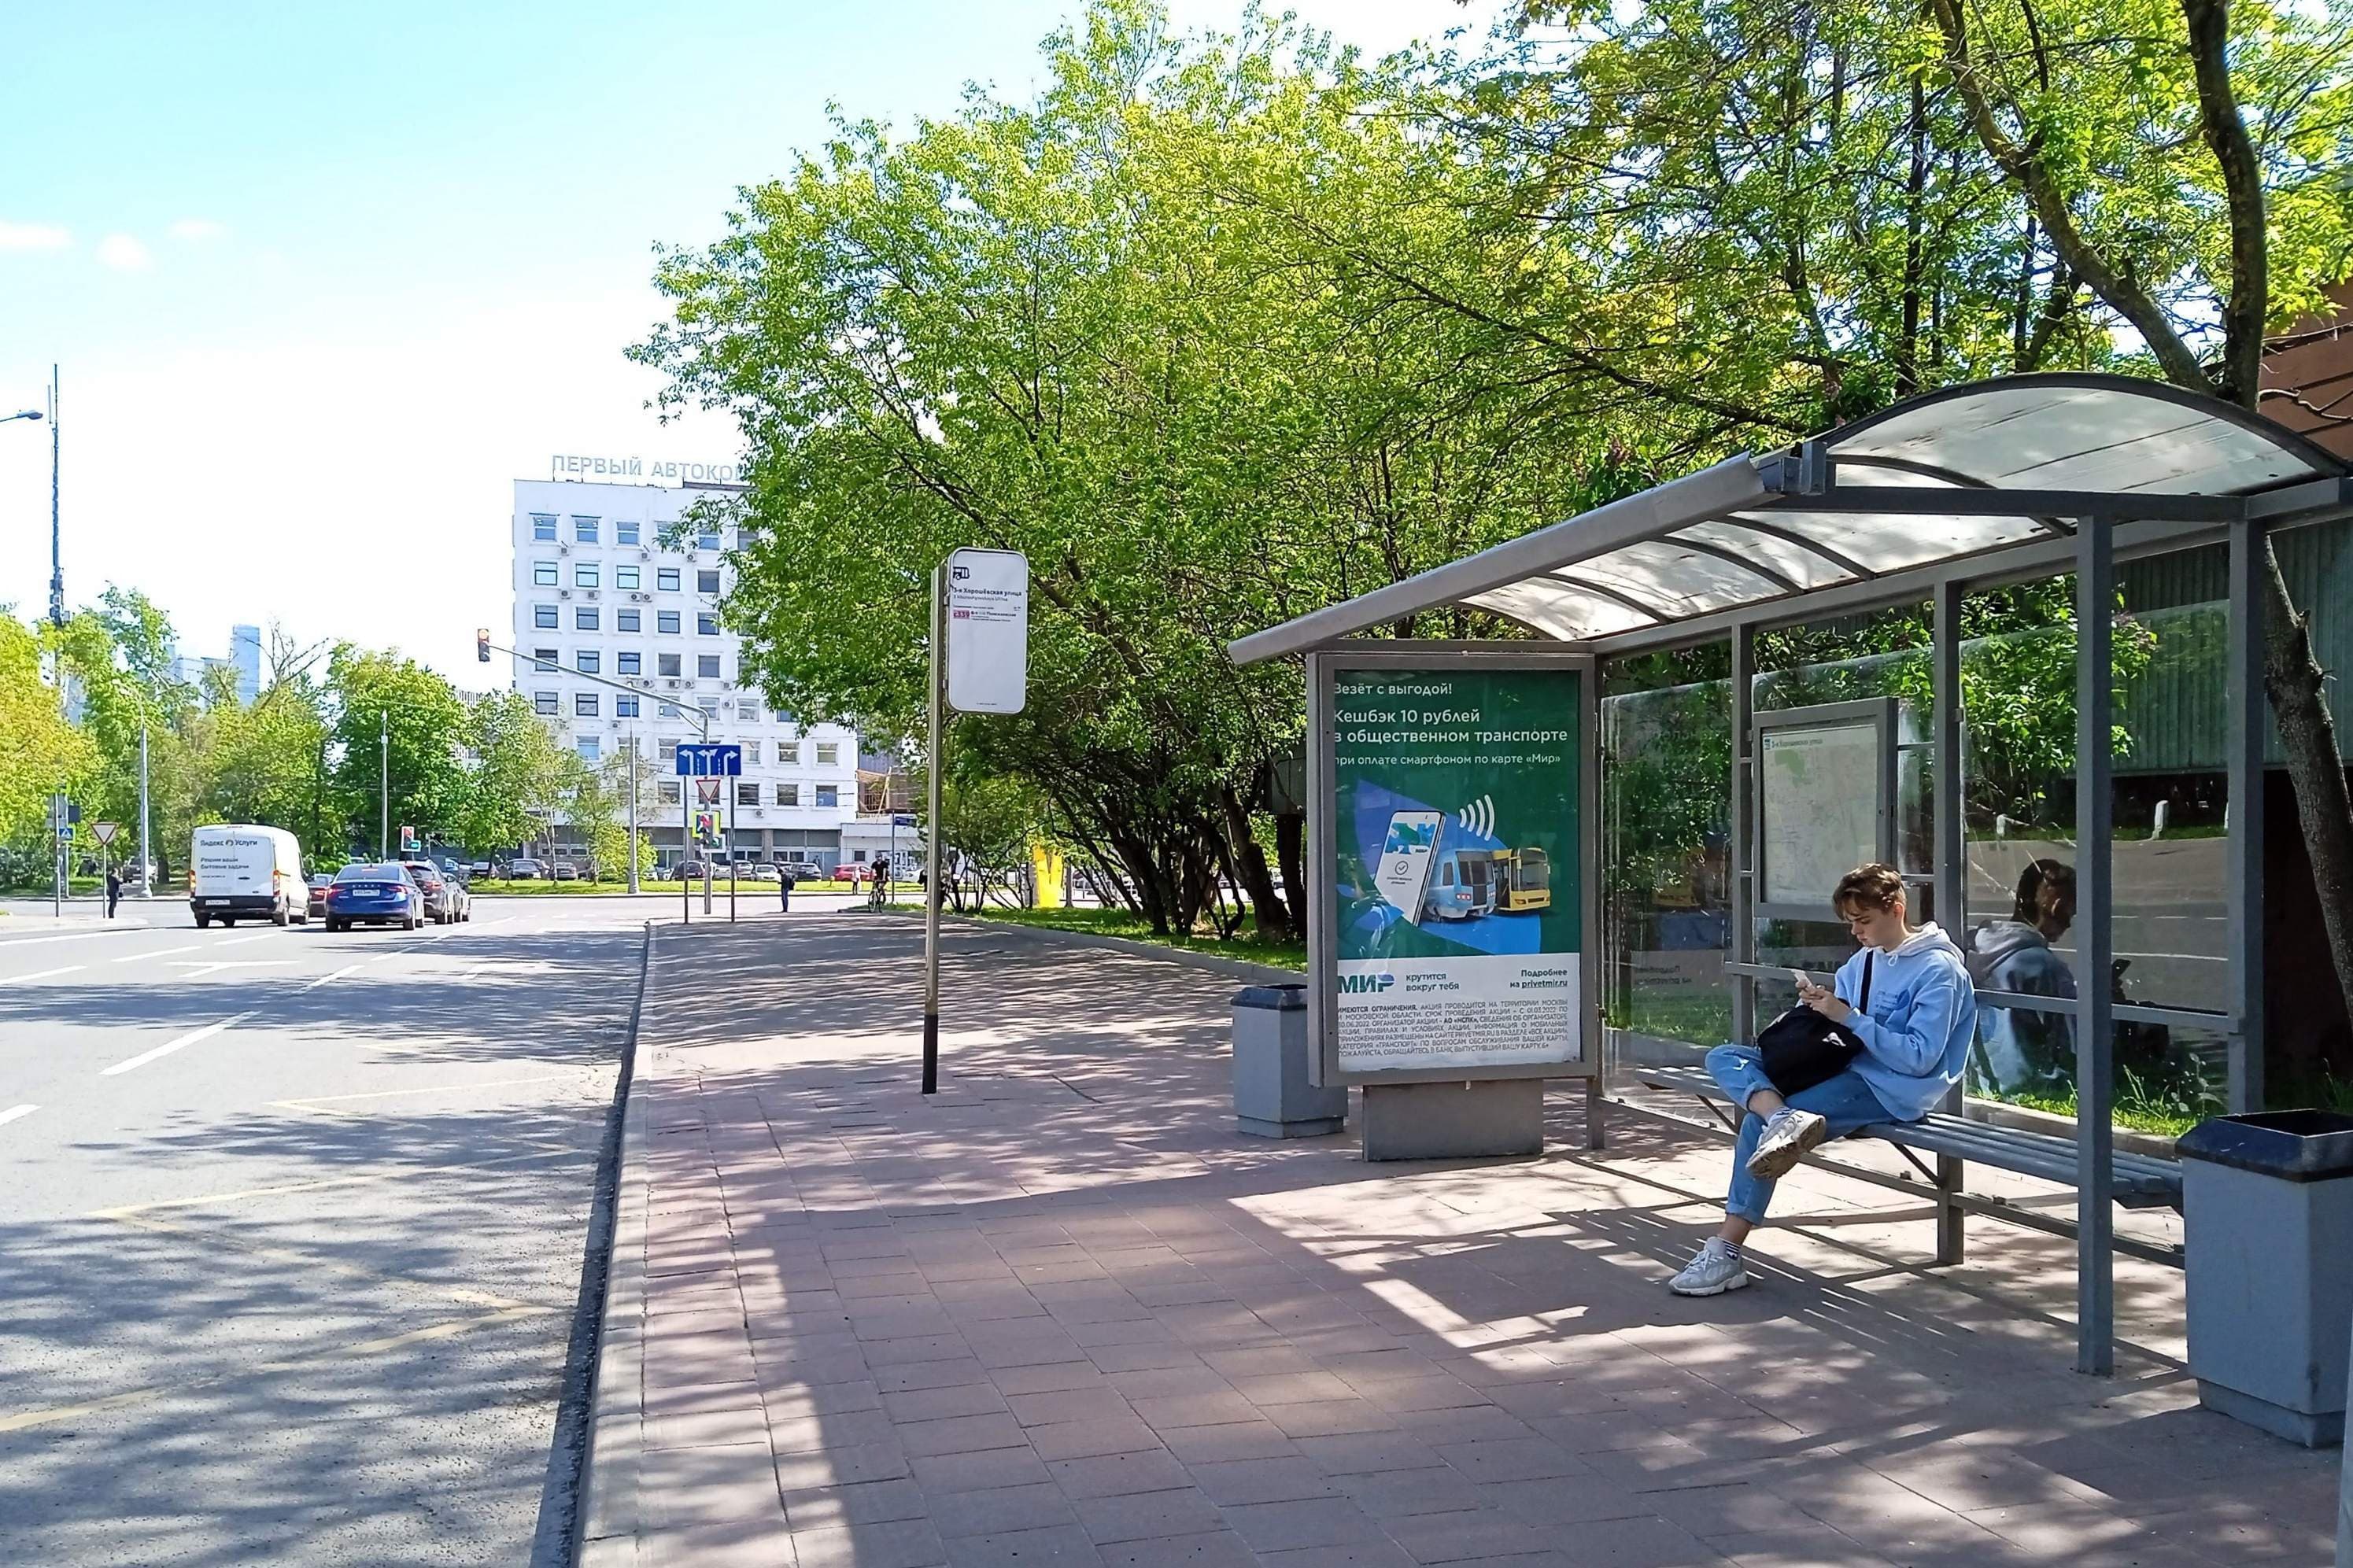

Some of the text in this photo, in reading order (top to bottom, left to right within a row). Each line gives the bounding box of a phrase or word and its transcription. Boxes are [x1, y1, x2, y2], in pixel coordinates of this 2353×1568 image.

[552, 455, 742, 481] ПЕРВЫЙ АВТОКО
[1334, 683, 1452, 696] Везёт с выгодой!
[1334, 708, 1480, 725] Кешбэк 10 рублей
[1346, 729, 1469, 744] общественном
[1474, 730, 1568, 744] транспорте
[1358, 756, 1398, 765] оплате
[1400, 754, 1472, 766] смартфоном
[1474, 755, 1488, 764] по
[1491, 755, 1523, 765] карте
[1526, 753, 1561, 764] «Мир»
[1406, 972, 1446, 982] крутится
[1520, 969, 1568, 978] Подробнее
[1338, 974, 1394, 994] МИР
[1406, 982, 1460, 992] вокруг тебя
[1521, 979, 1568, 989] privetmir.ru
[1345, 1012, 1389, 1020] МОСКОВСКОЙ
